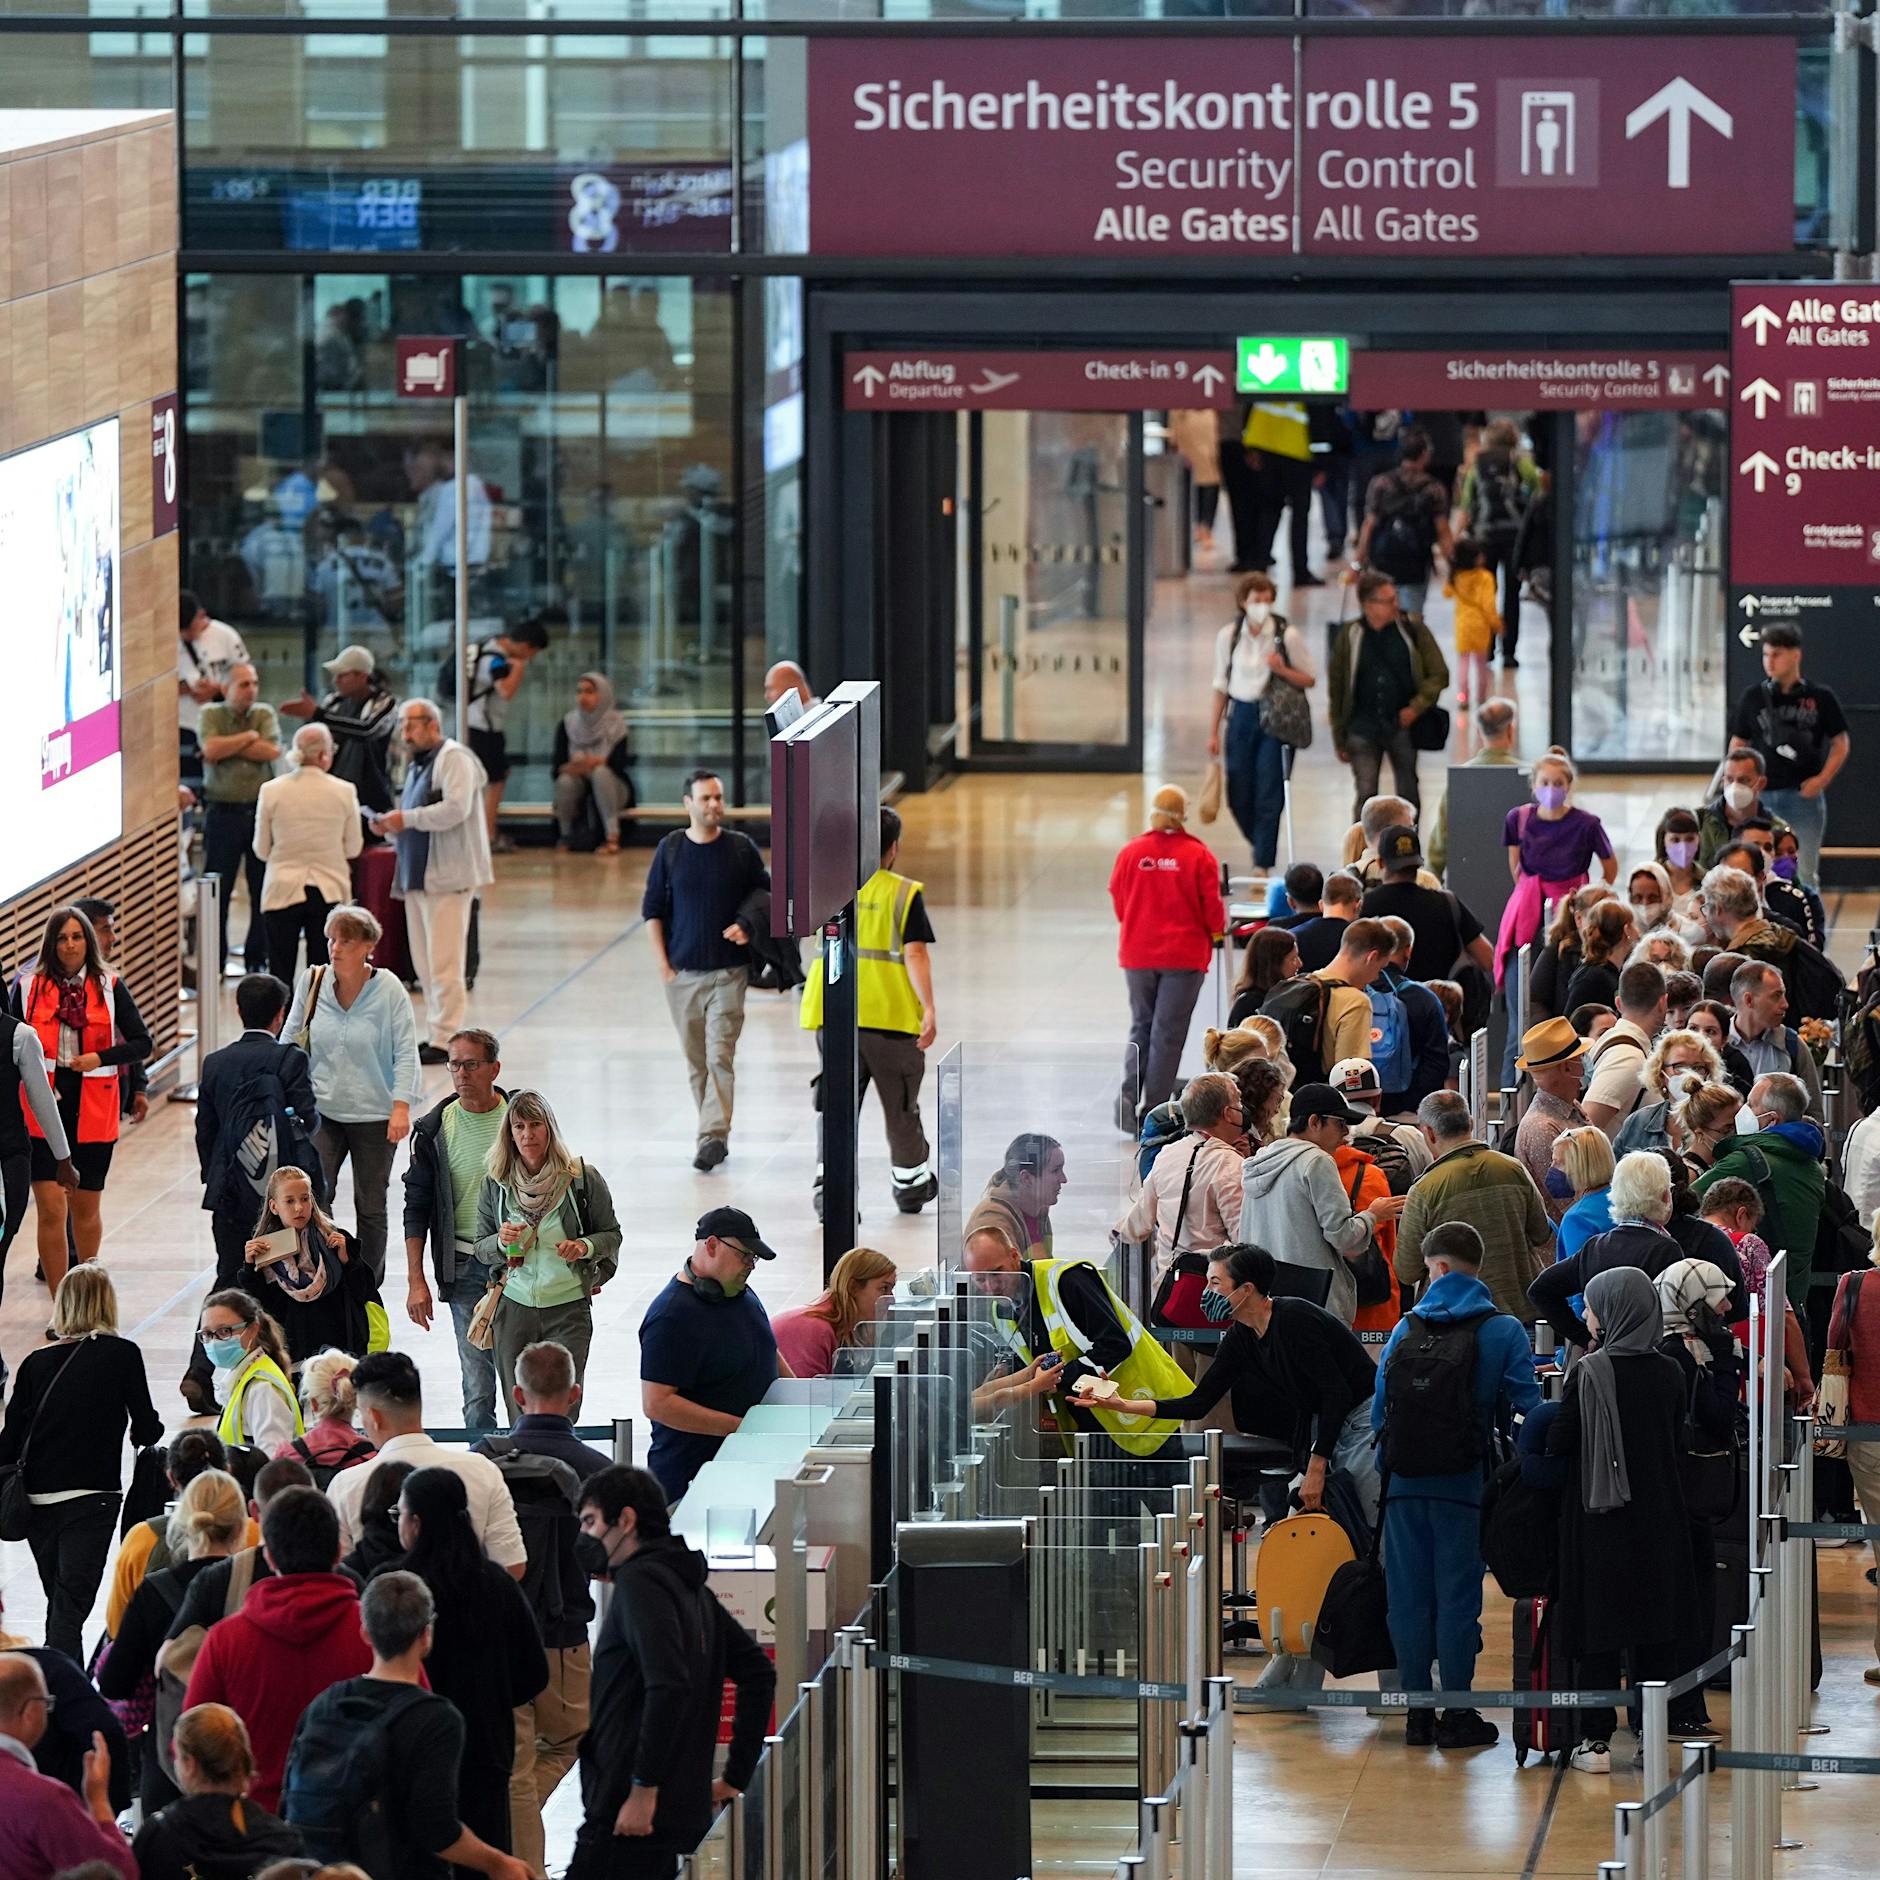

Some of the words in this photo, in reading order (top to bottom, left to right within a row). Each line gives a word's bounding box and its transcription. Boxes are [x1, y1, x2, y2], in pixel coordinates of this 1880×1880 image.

[853, 78, 1434, 131] Sicherheitskontrolle
[1448, 81, 1480, 131] 5
[1115, 147, 1293, 200] Security
[1317, 146, 1478, 190] Control
[1093, 204, 1172, 242] Alle
[1180, 206, 1290, 243] Gates
[1313, 203, 1365, 242] All
[1374, 206, 1480, 243] Gates
[1785, 298, 1837, 324] Alle
[1785, 325, 1813, 346] All
[1815, 326, 1870, 347] Gates
[888, 360, 956, 383] Abflug
[1084, 359, 1170, 380] Check-in
[1174, 360, 1189, 380] 9
[1446, 359, 1643, 380] Sicherheitskontrolle
[1647, 360, 1660, 379] 5
[888, 382, 965, 400] Departure
[1539, 381, 1600, 401] Security
[1603, 381, 1660, 399] Control
[164, 407, 177, 504] 8
[1785, 472, 1802, 496] 9
[235, 1118, 270, 1178] NIKE
[1361, 1331, 1384, 1343] BER
[889, 1654, 910, 1670] BER
[1013, 1670, 1034, 1685] BER
[1138, 1683, 1160, 1698] BER
[1380, 1692, 1409, 1706] BER
[1551, 1692, 1579, 1706] BER
[1811, 1758, 1839, 1773] BER
